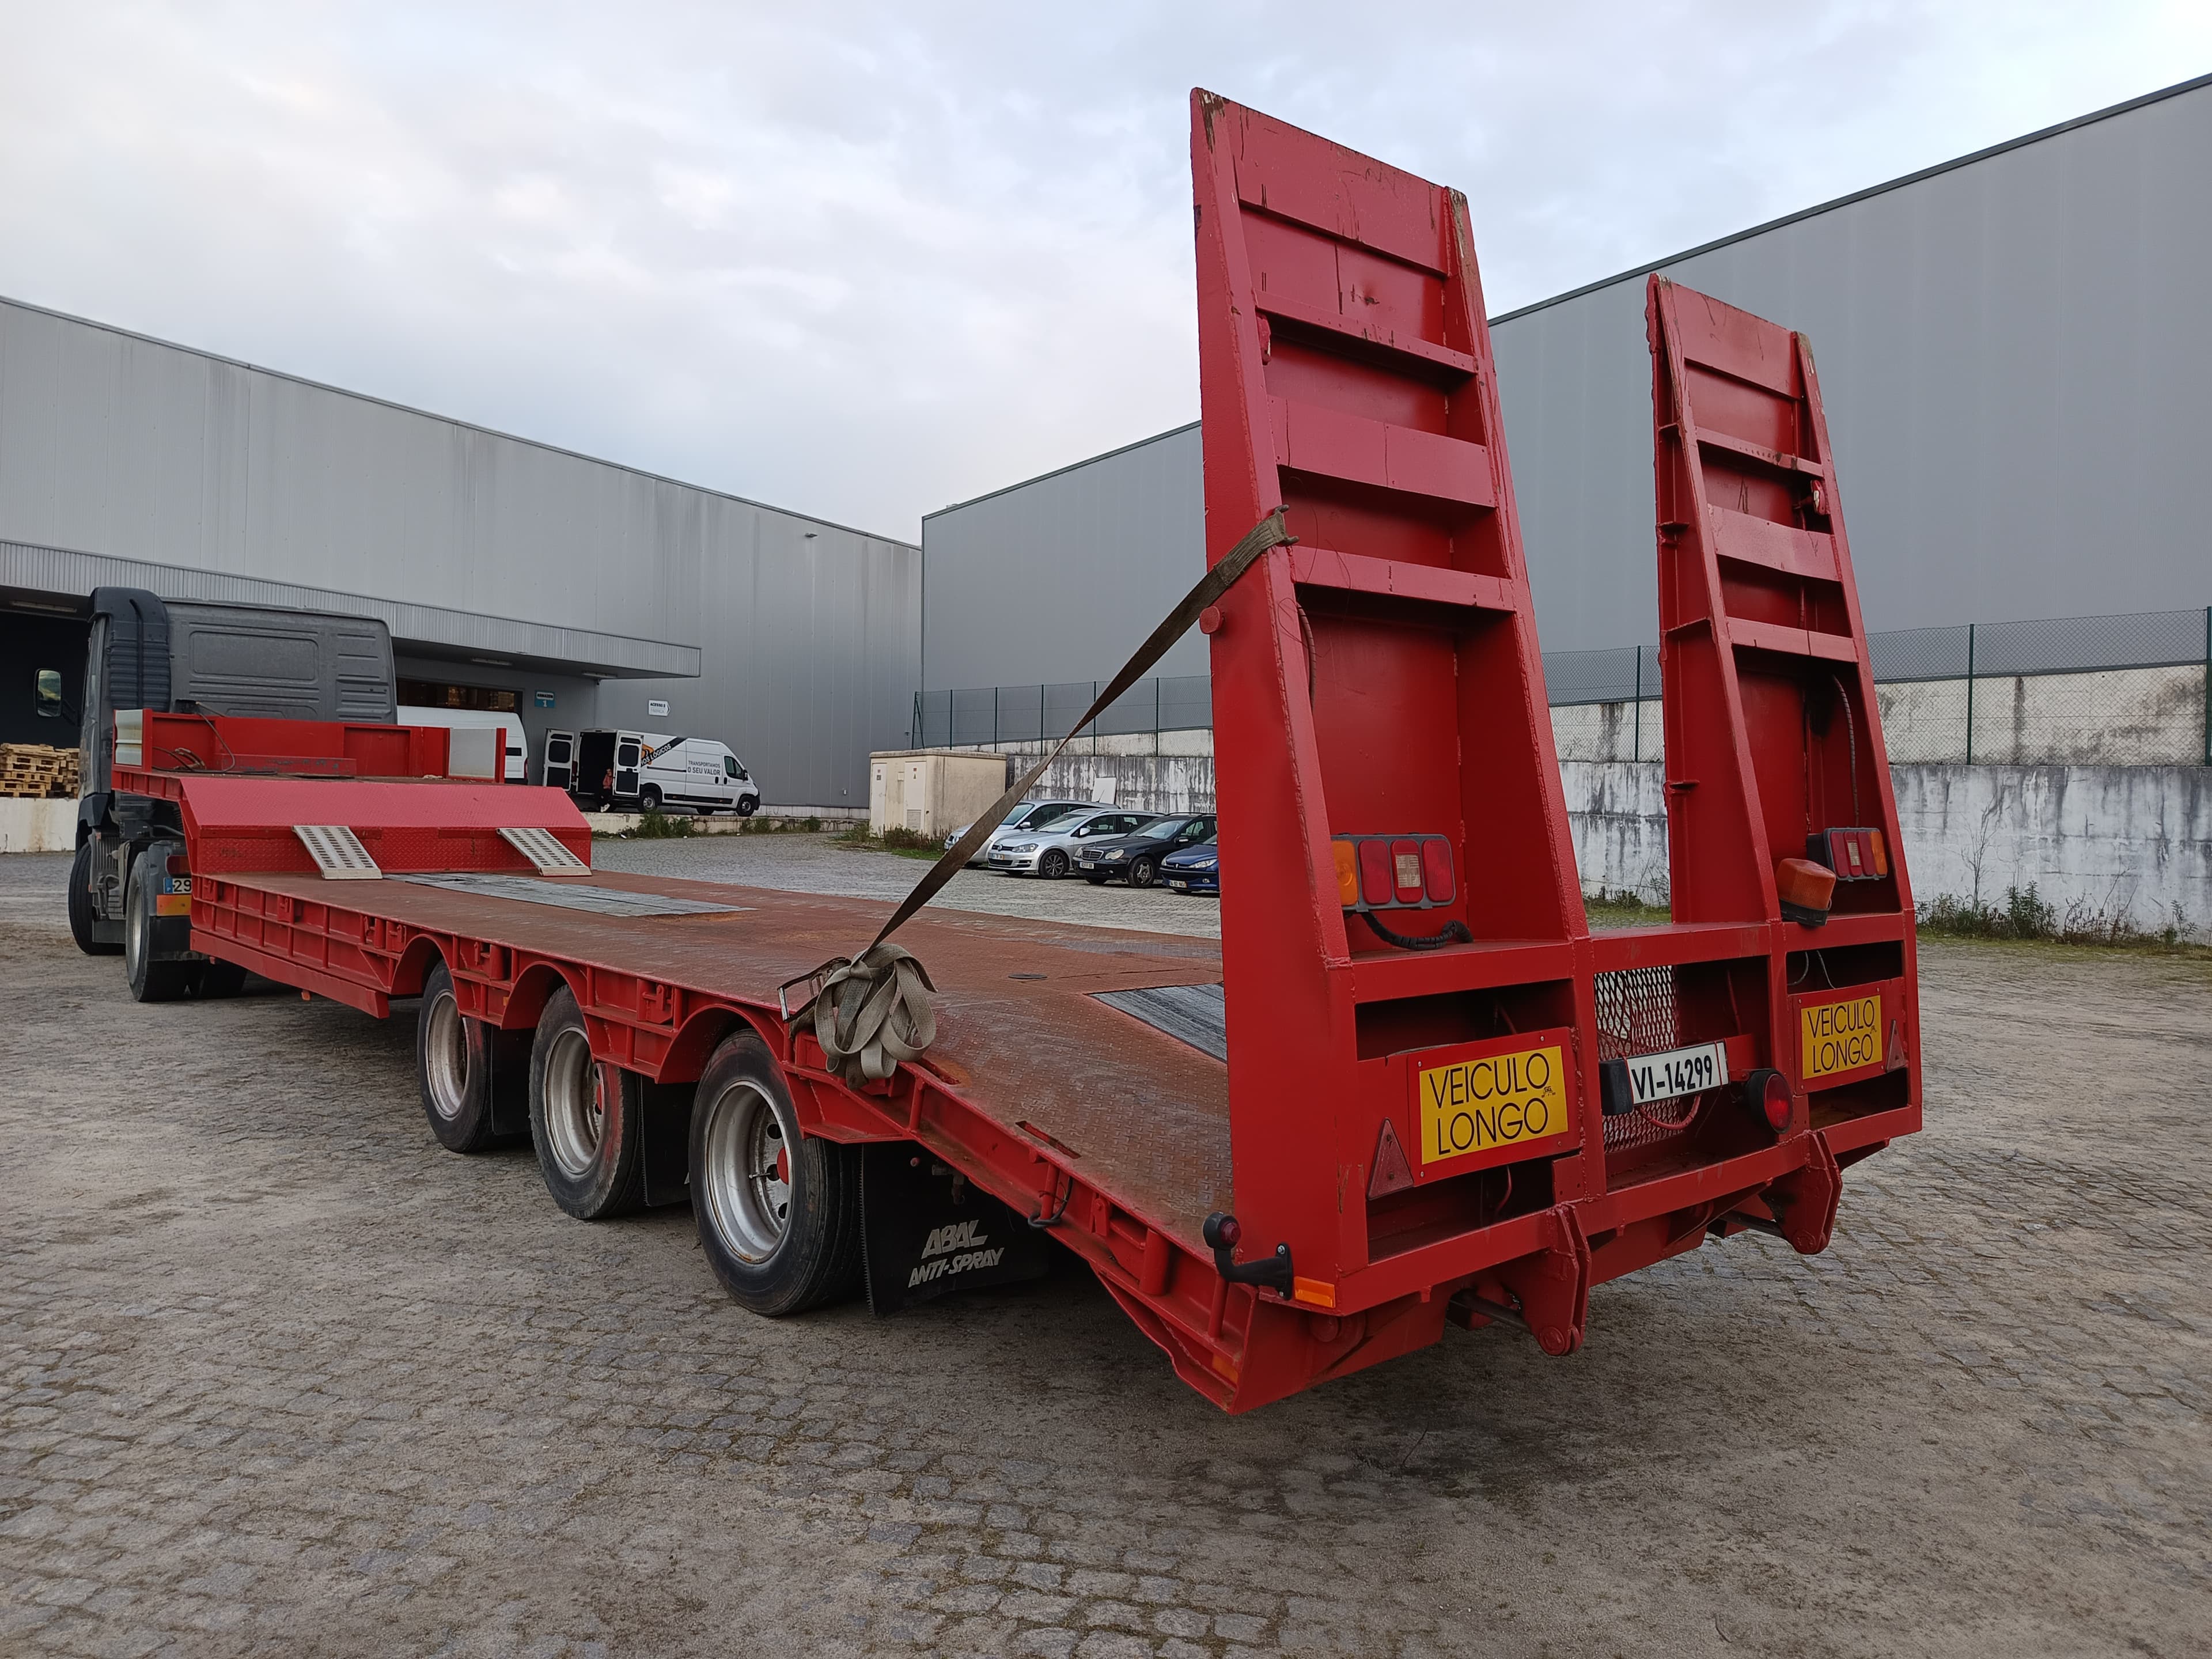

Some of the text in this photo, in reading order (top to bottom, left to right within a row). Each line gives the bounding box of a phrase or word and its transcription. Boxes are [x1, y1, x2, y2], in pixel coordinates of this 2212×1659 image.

[688, 760, 720, 768] TRANSPORTAMOS
[704, 768, 721, 776] VALOR
[1807, 999, 1874, 1038] VEICULO
[1813, 1033, 1873, 1073] LONGO
[1429, 1052, 1550, 1109] VEICULO
[1631, 1055, 1713, 1100] VI-14299
[1437, 1097, 1548, 1155] LONGO
[921, 1219, 988, 1259] ABAL
[908, 1247, 1005, 1288] ANTI-SPRAY
